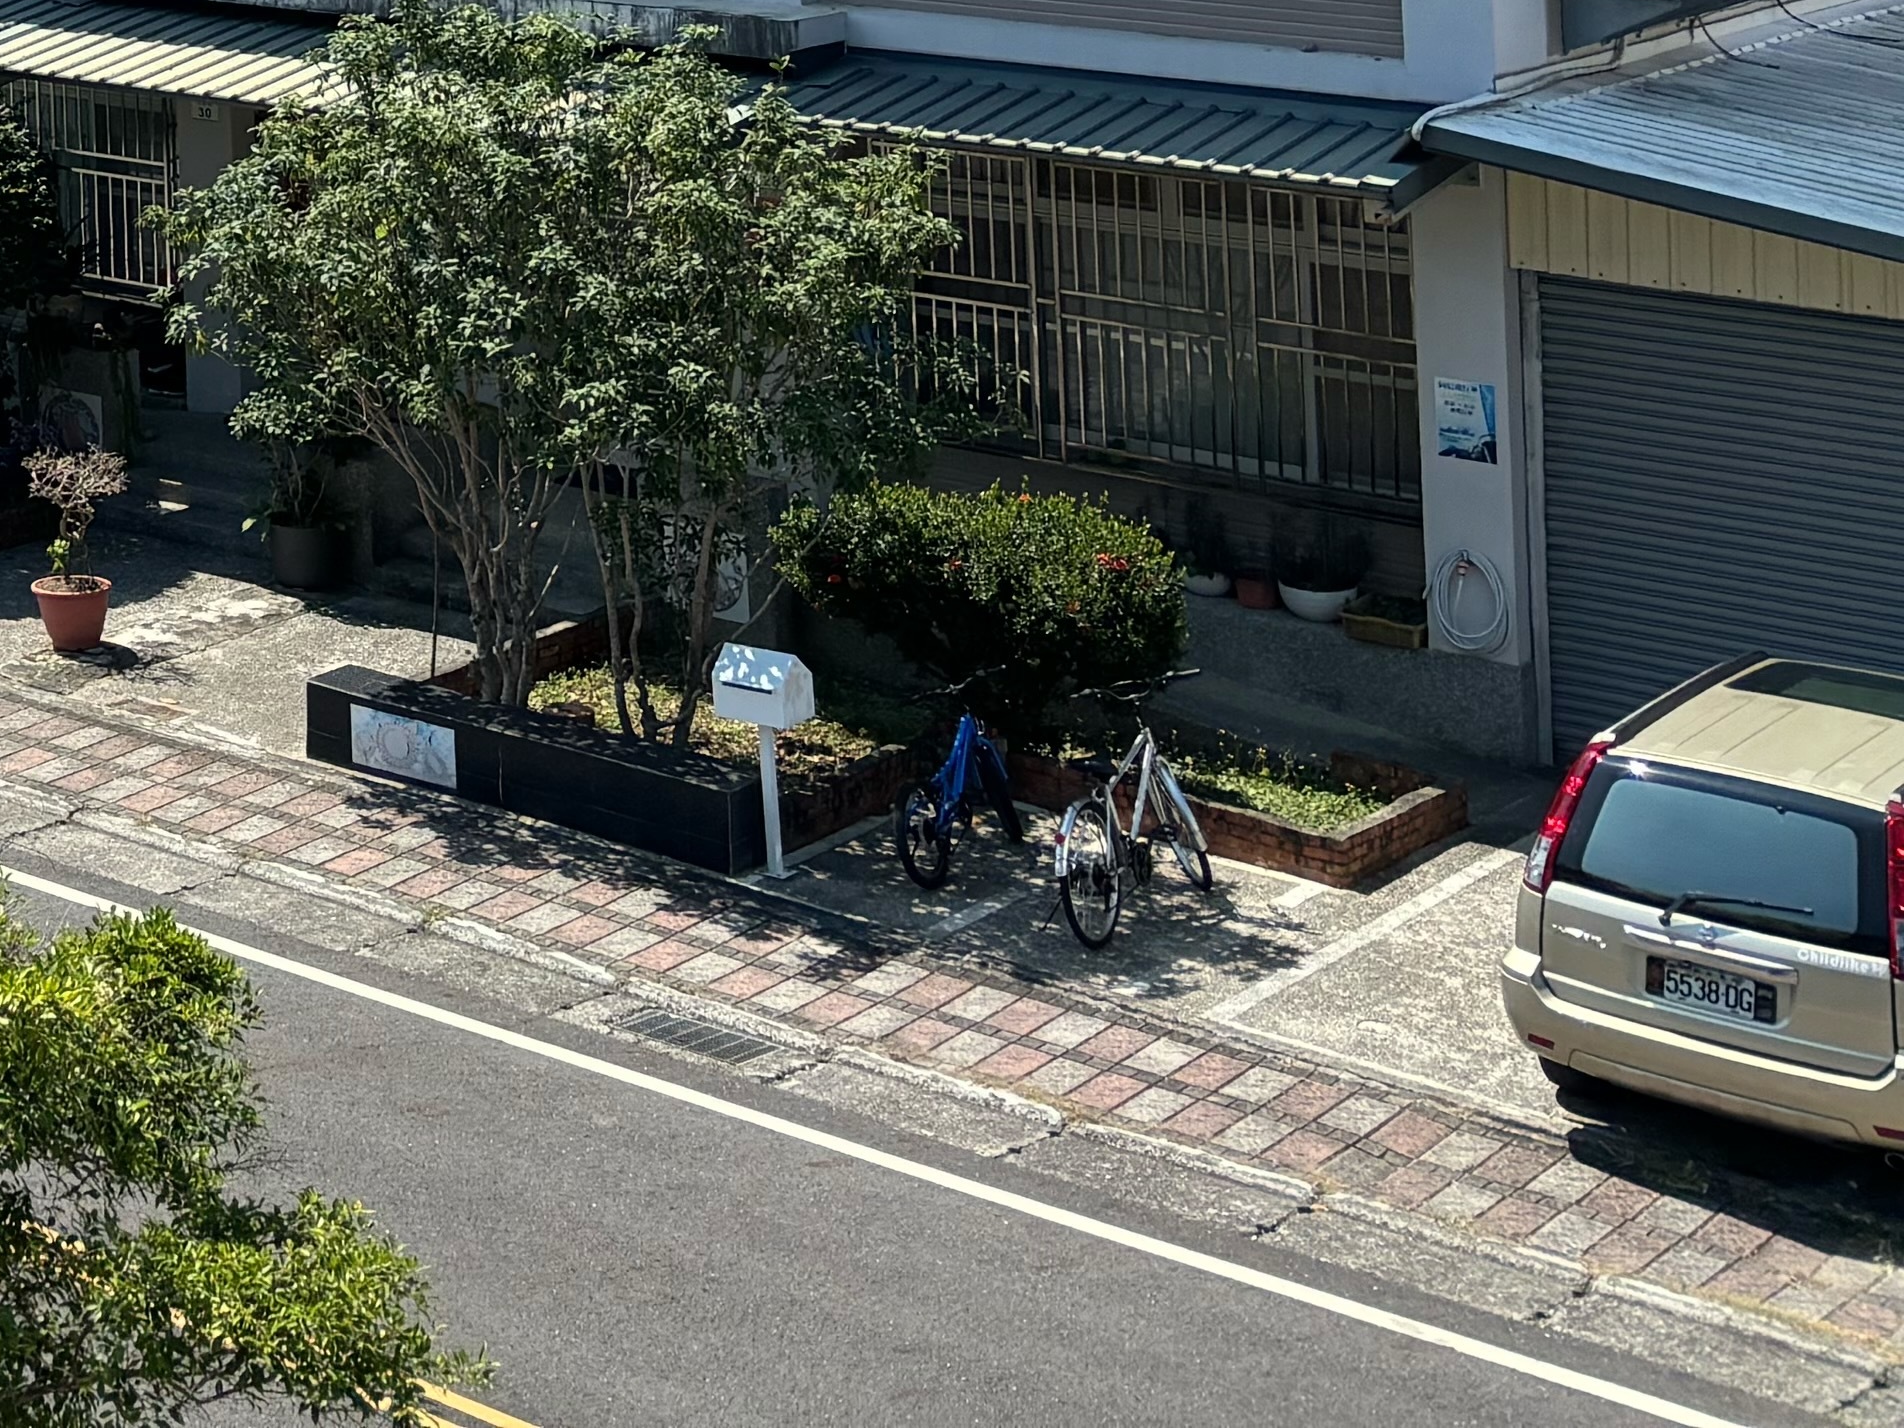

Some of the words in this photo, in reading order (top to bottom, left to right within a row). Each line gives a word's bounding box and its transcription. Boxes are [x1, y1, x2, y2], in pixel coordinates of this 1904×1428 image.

[198, 107, 211, 119] 30
[1796, 948, 1870, 975] Childlike
[1665, 969, 1754, 1013] 5538-DG
